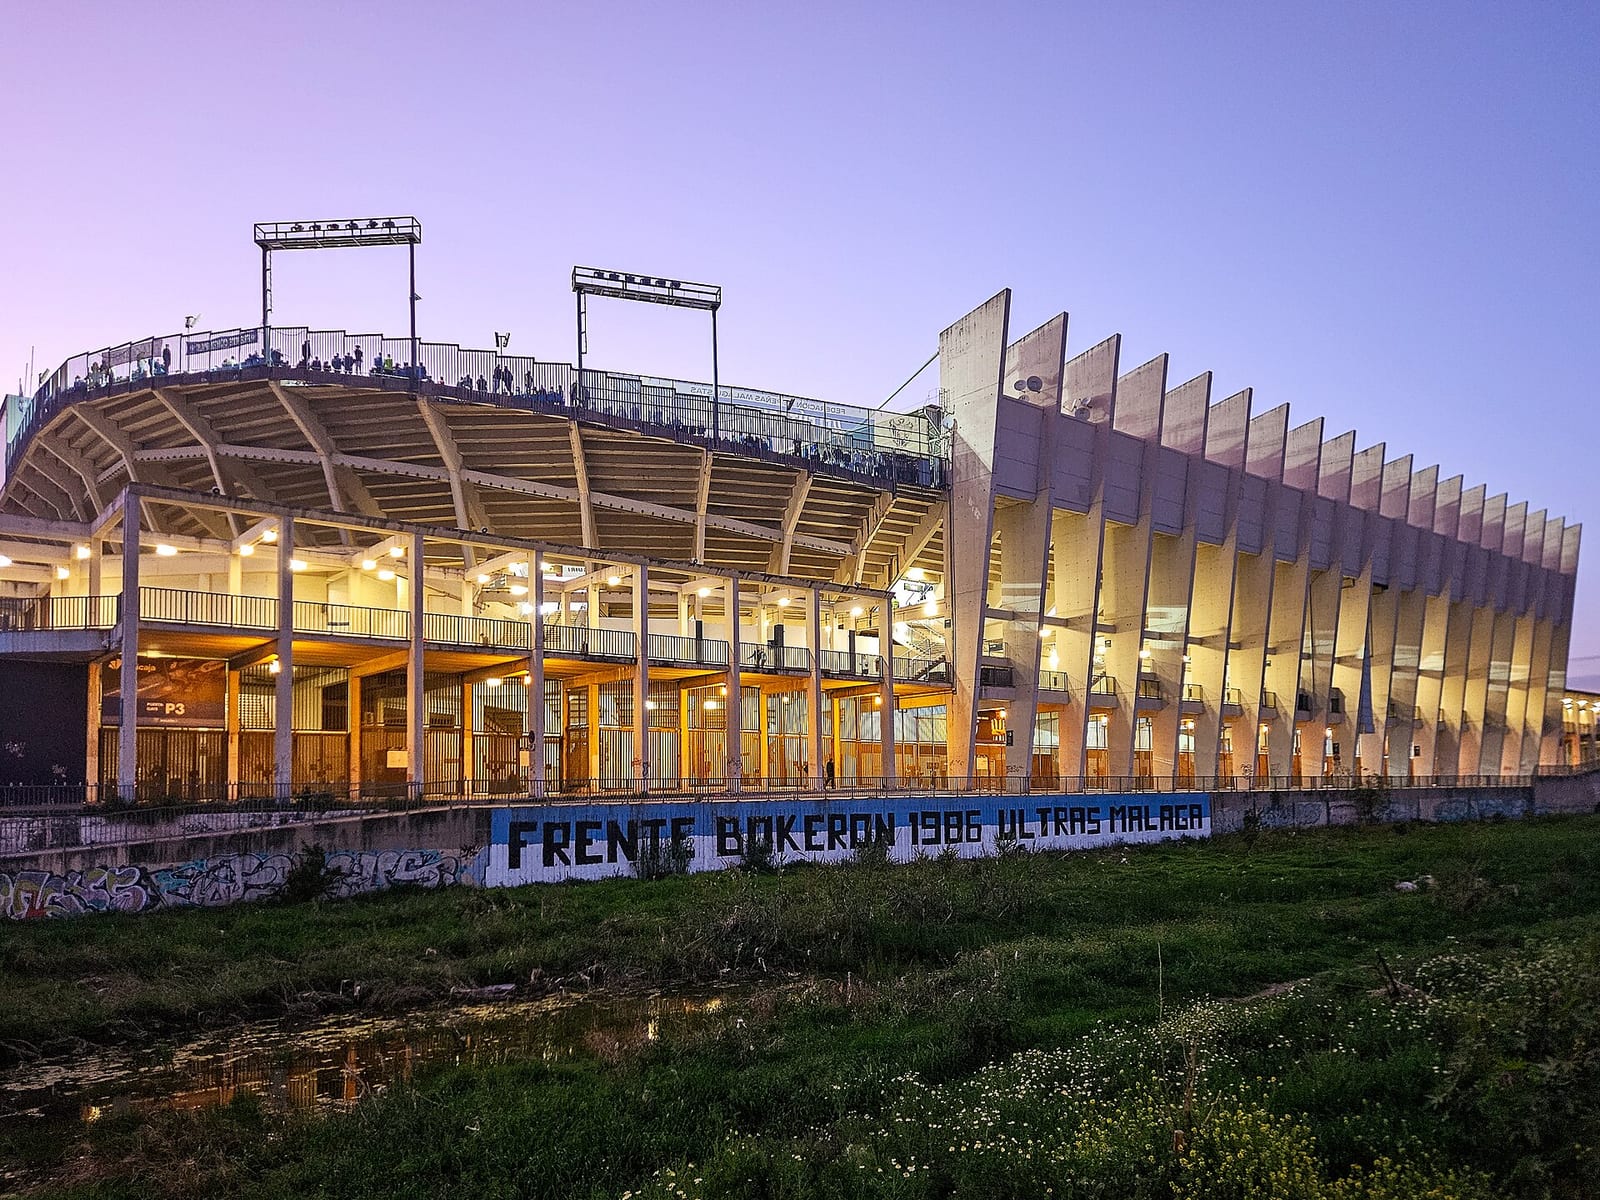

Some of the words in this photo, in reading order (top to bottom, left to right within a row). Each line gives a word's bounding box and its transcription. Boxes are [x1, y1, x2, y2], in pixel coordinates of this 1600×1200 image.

[165, 702, 185, 715] P3
[508, 816, 696, 869] FRENTE
[716, 813, 896, 857] BOKERON
[909, 809, 981, 846] 1986
[999, 805, 1101, 840] ULTRAS
[1109, 803, 1203, 833] MALAGA
